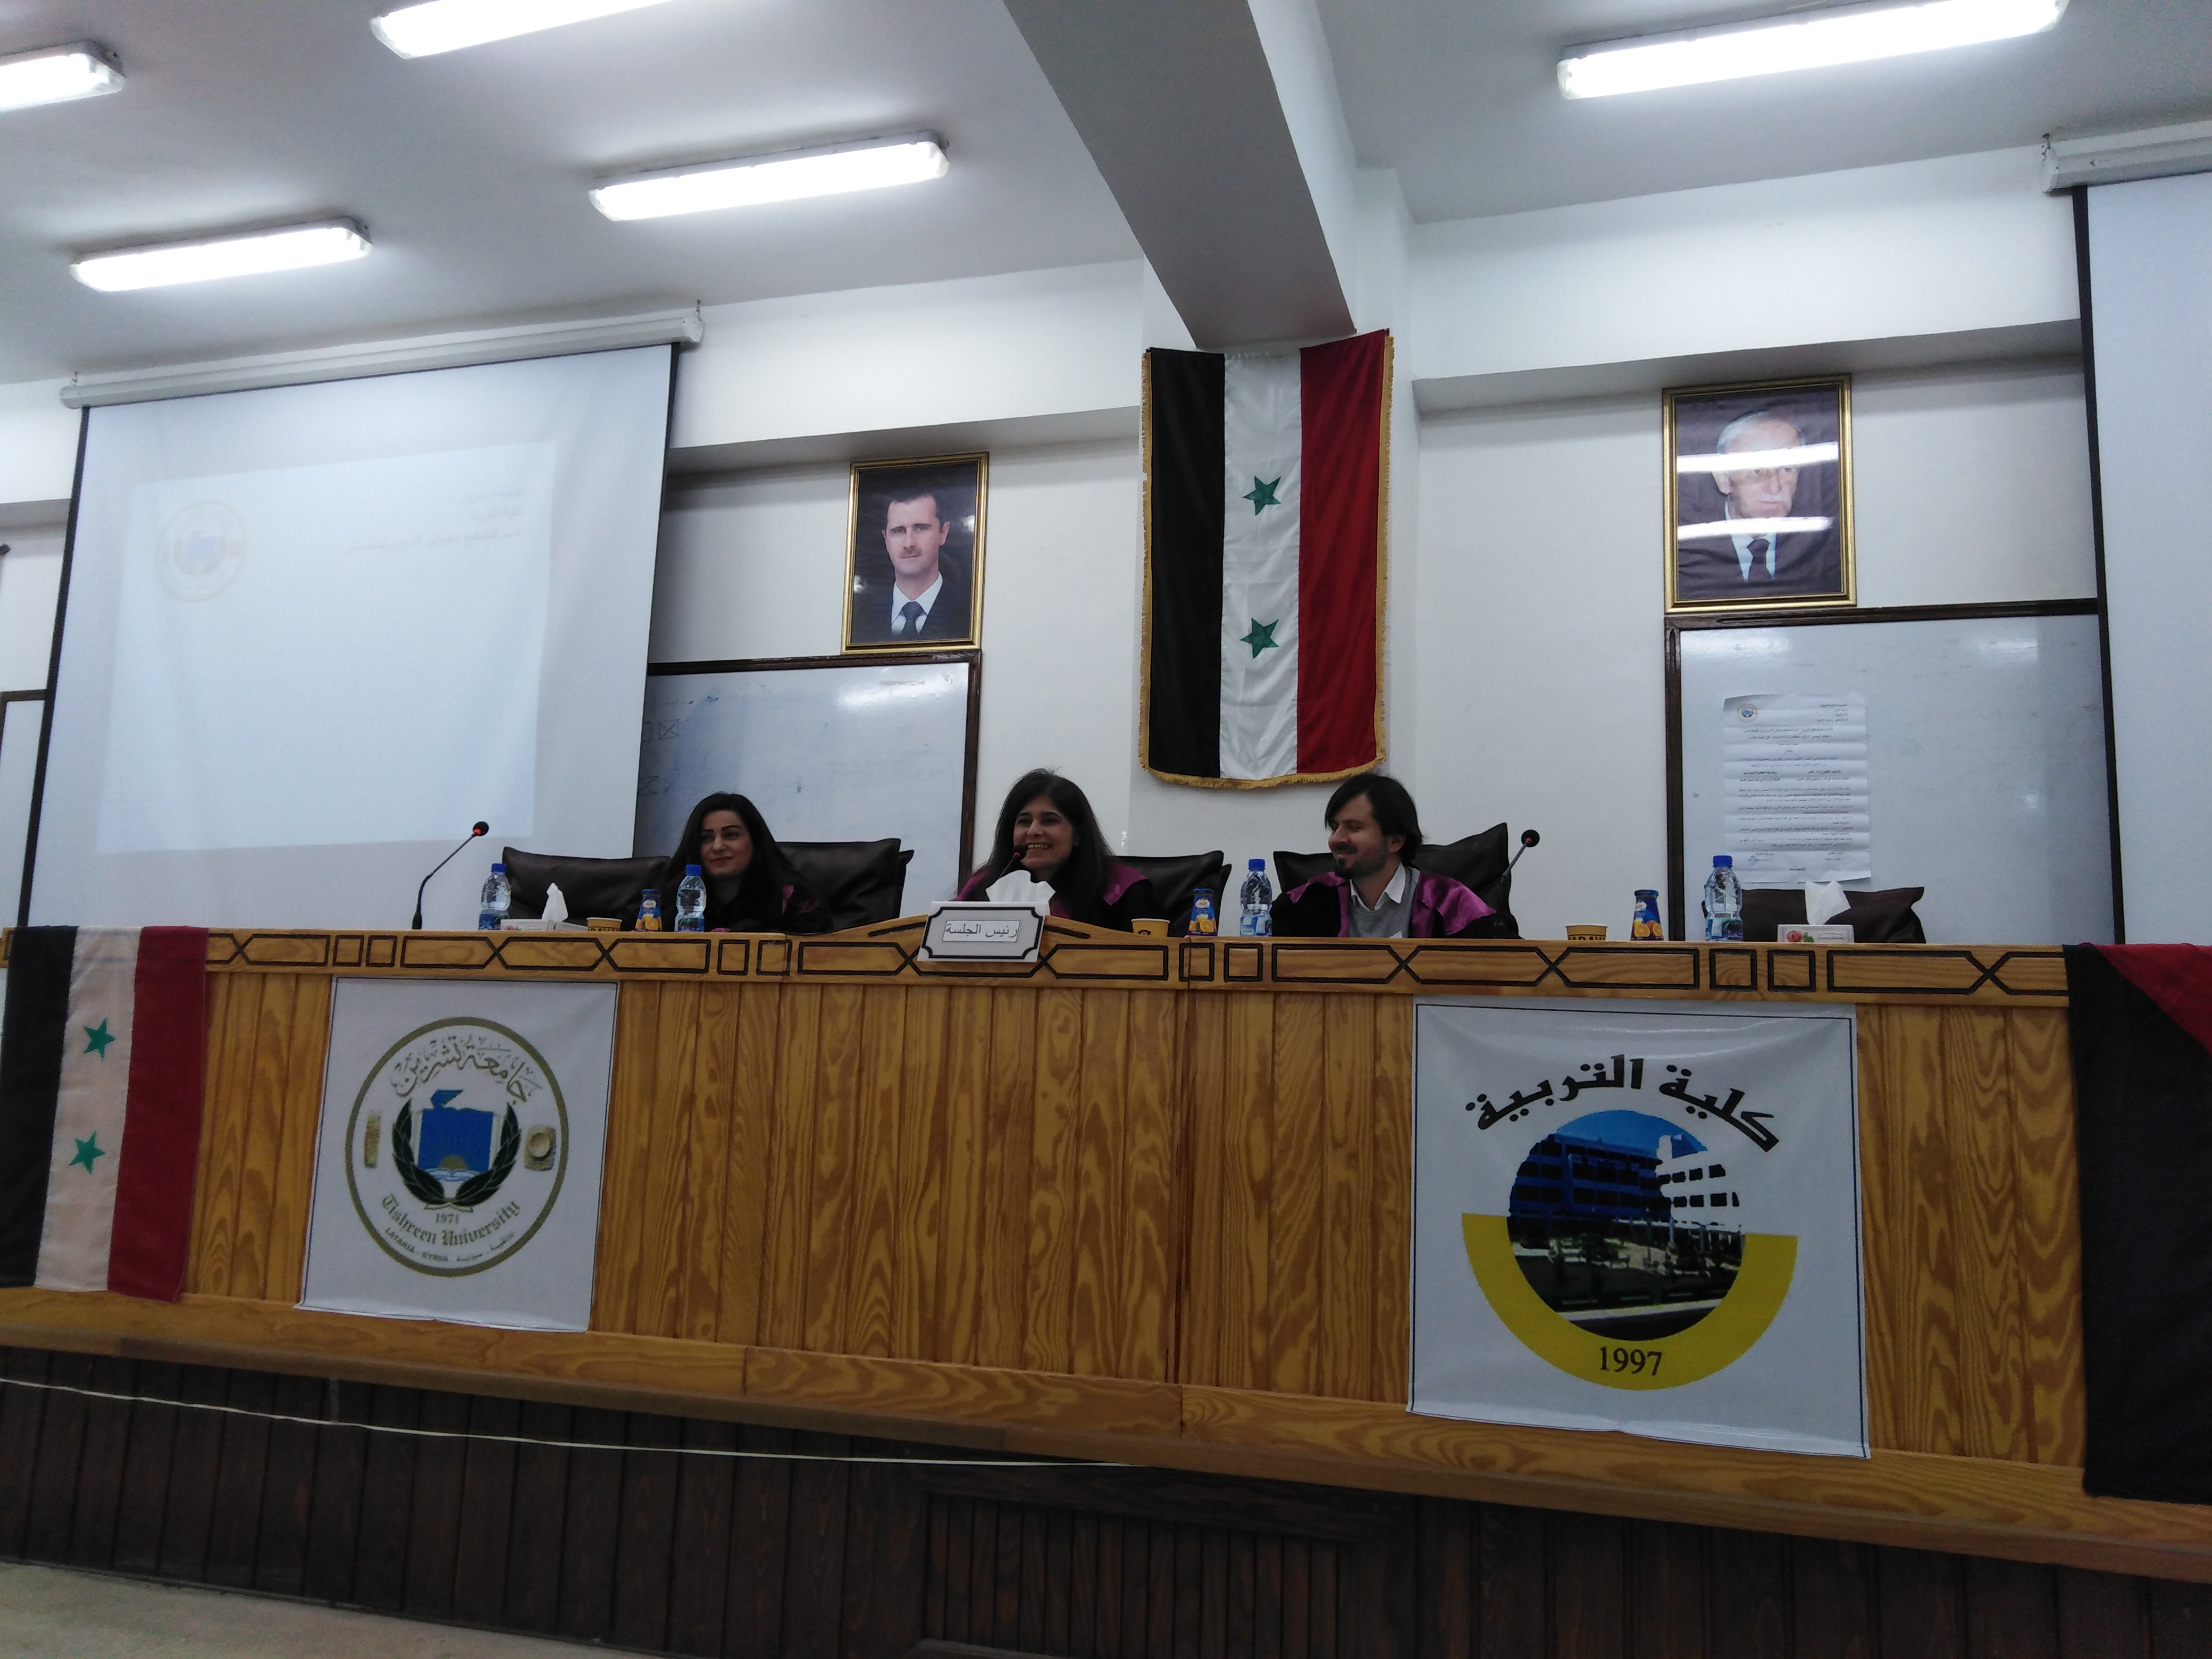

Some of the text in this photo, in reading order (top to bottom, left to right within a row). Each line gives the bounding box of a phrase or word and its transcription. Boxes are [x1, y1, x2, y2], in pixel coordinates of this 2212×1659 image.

[945, 923, 1018, 938] رئيس الجلسة
[393, 1036, 531, 1105] جامعة تشرين
[1464, 1054, 1780, 1152] كلية التربية
[382, 1194, 437, 1244] Tishreen
[441, 1201, 521, 1246] University
[435, 1213, 459, 1224] 1971
[1598, 1346, 1663, 1376] 1997
